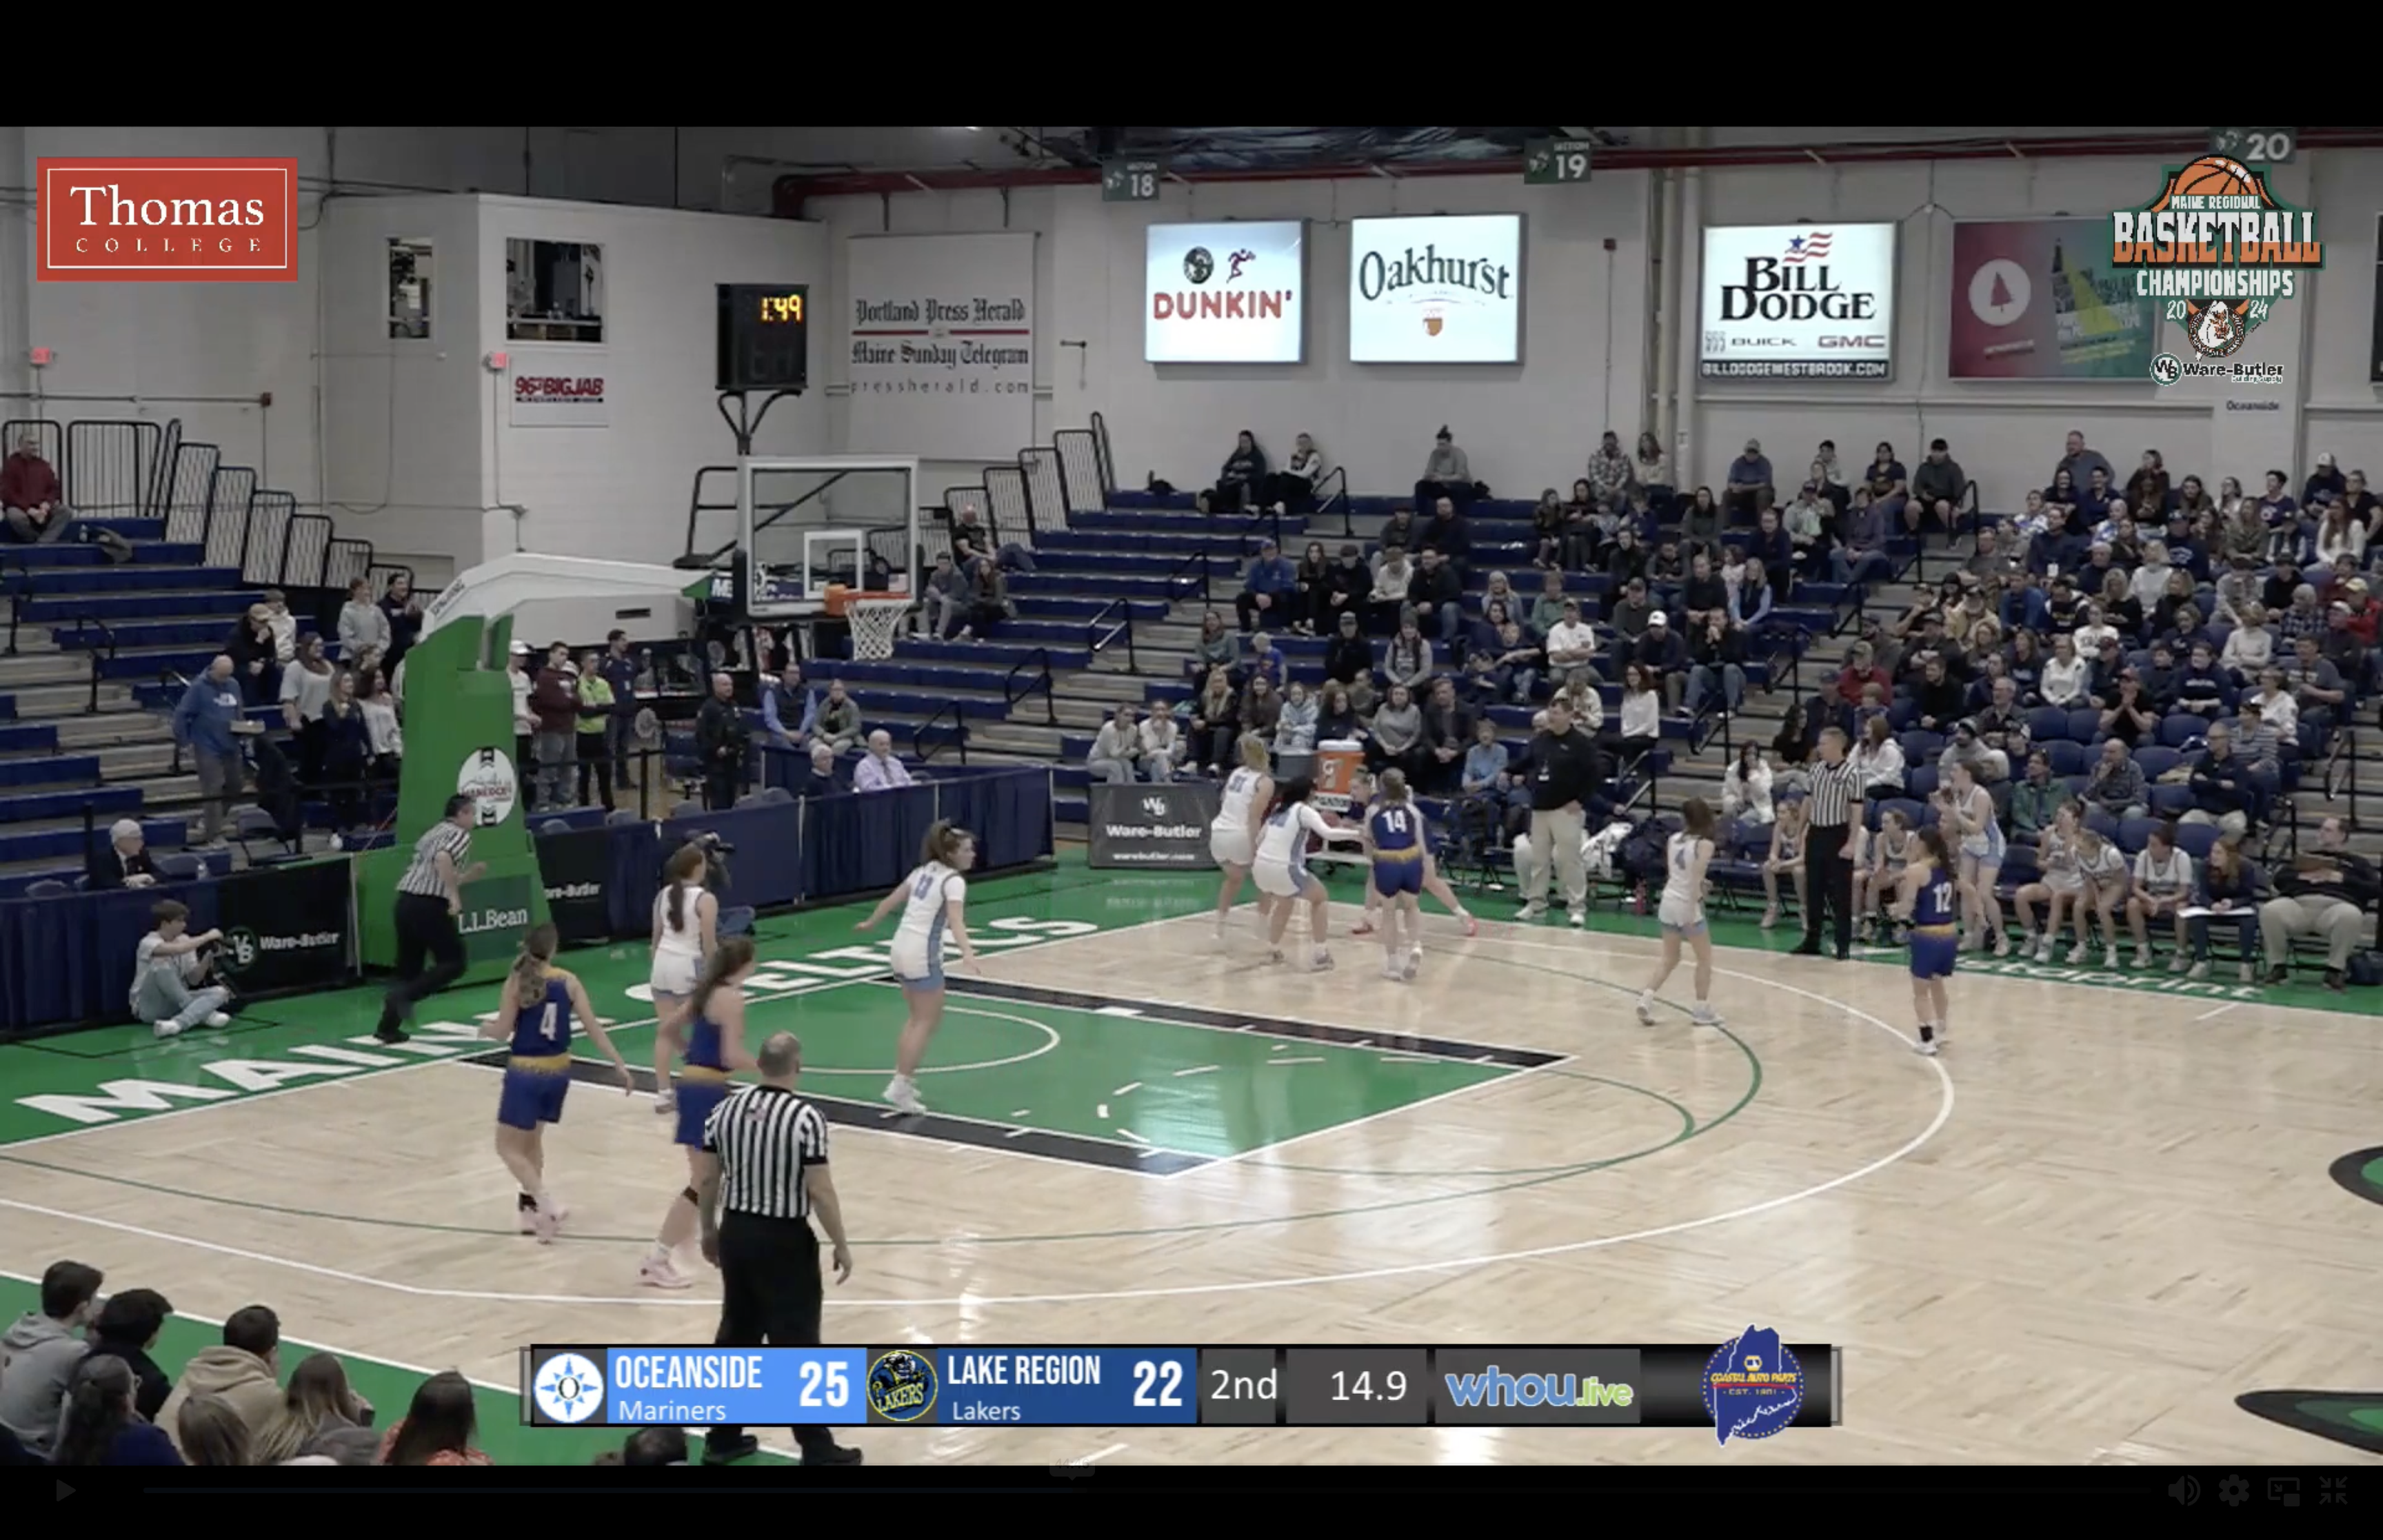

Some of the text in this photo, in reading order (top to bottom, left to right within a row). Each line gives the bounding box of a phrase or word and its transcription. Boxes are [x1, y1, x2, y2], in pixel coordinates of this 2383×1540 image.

[2246, 133, 2291, 161] 20
[1556, 153, 1587, 179] 19
[1131, 174, 1155, 197] 18
[1359, 243, 1510, 301] Oakhurst
[1745, 256, 1842, 292] BILL
[761, 294, 801, 322] 1:49
[856, 297, 1026, 326] Portland Press Herald
[1154, 290, 1293, 320] DUNKIN'
[1720, 285, 1877, 321] DODGE
[852, 340, 1029, 370] Maine Sunday Telegram
[1731, 335, 1886, 348] BUICK GMC
[851, 378, 1029, 394] pressherald.com
[1106, 824, 1202, 838] Ware-Butler
[1380, 810, 1407, 833] 14
[1673, 847, 1687, 871] 4
[1932, 882, 1953, 913] 12
[458, 909, 527, 935] L.L.Bean
[259, 931, 340, 950] Ware-Butler
[539, 1002, 558, 1041] 4
